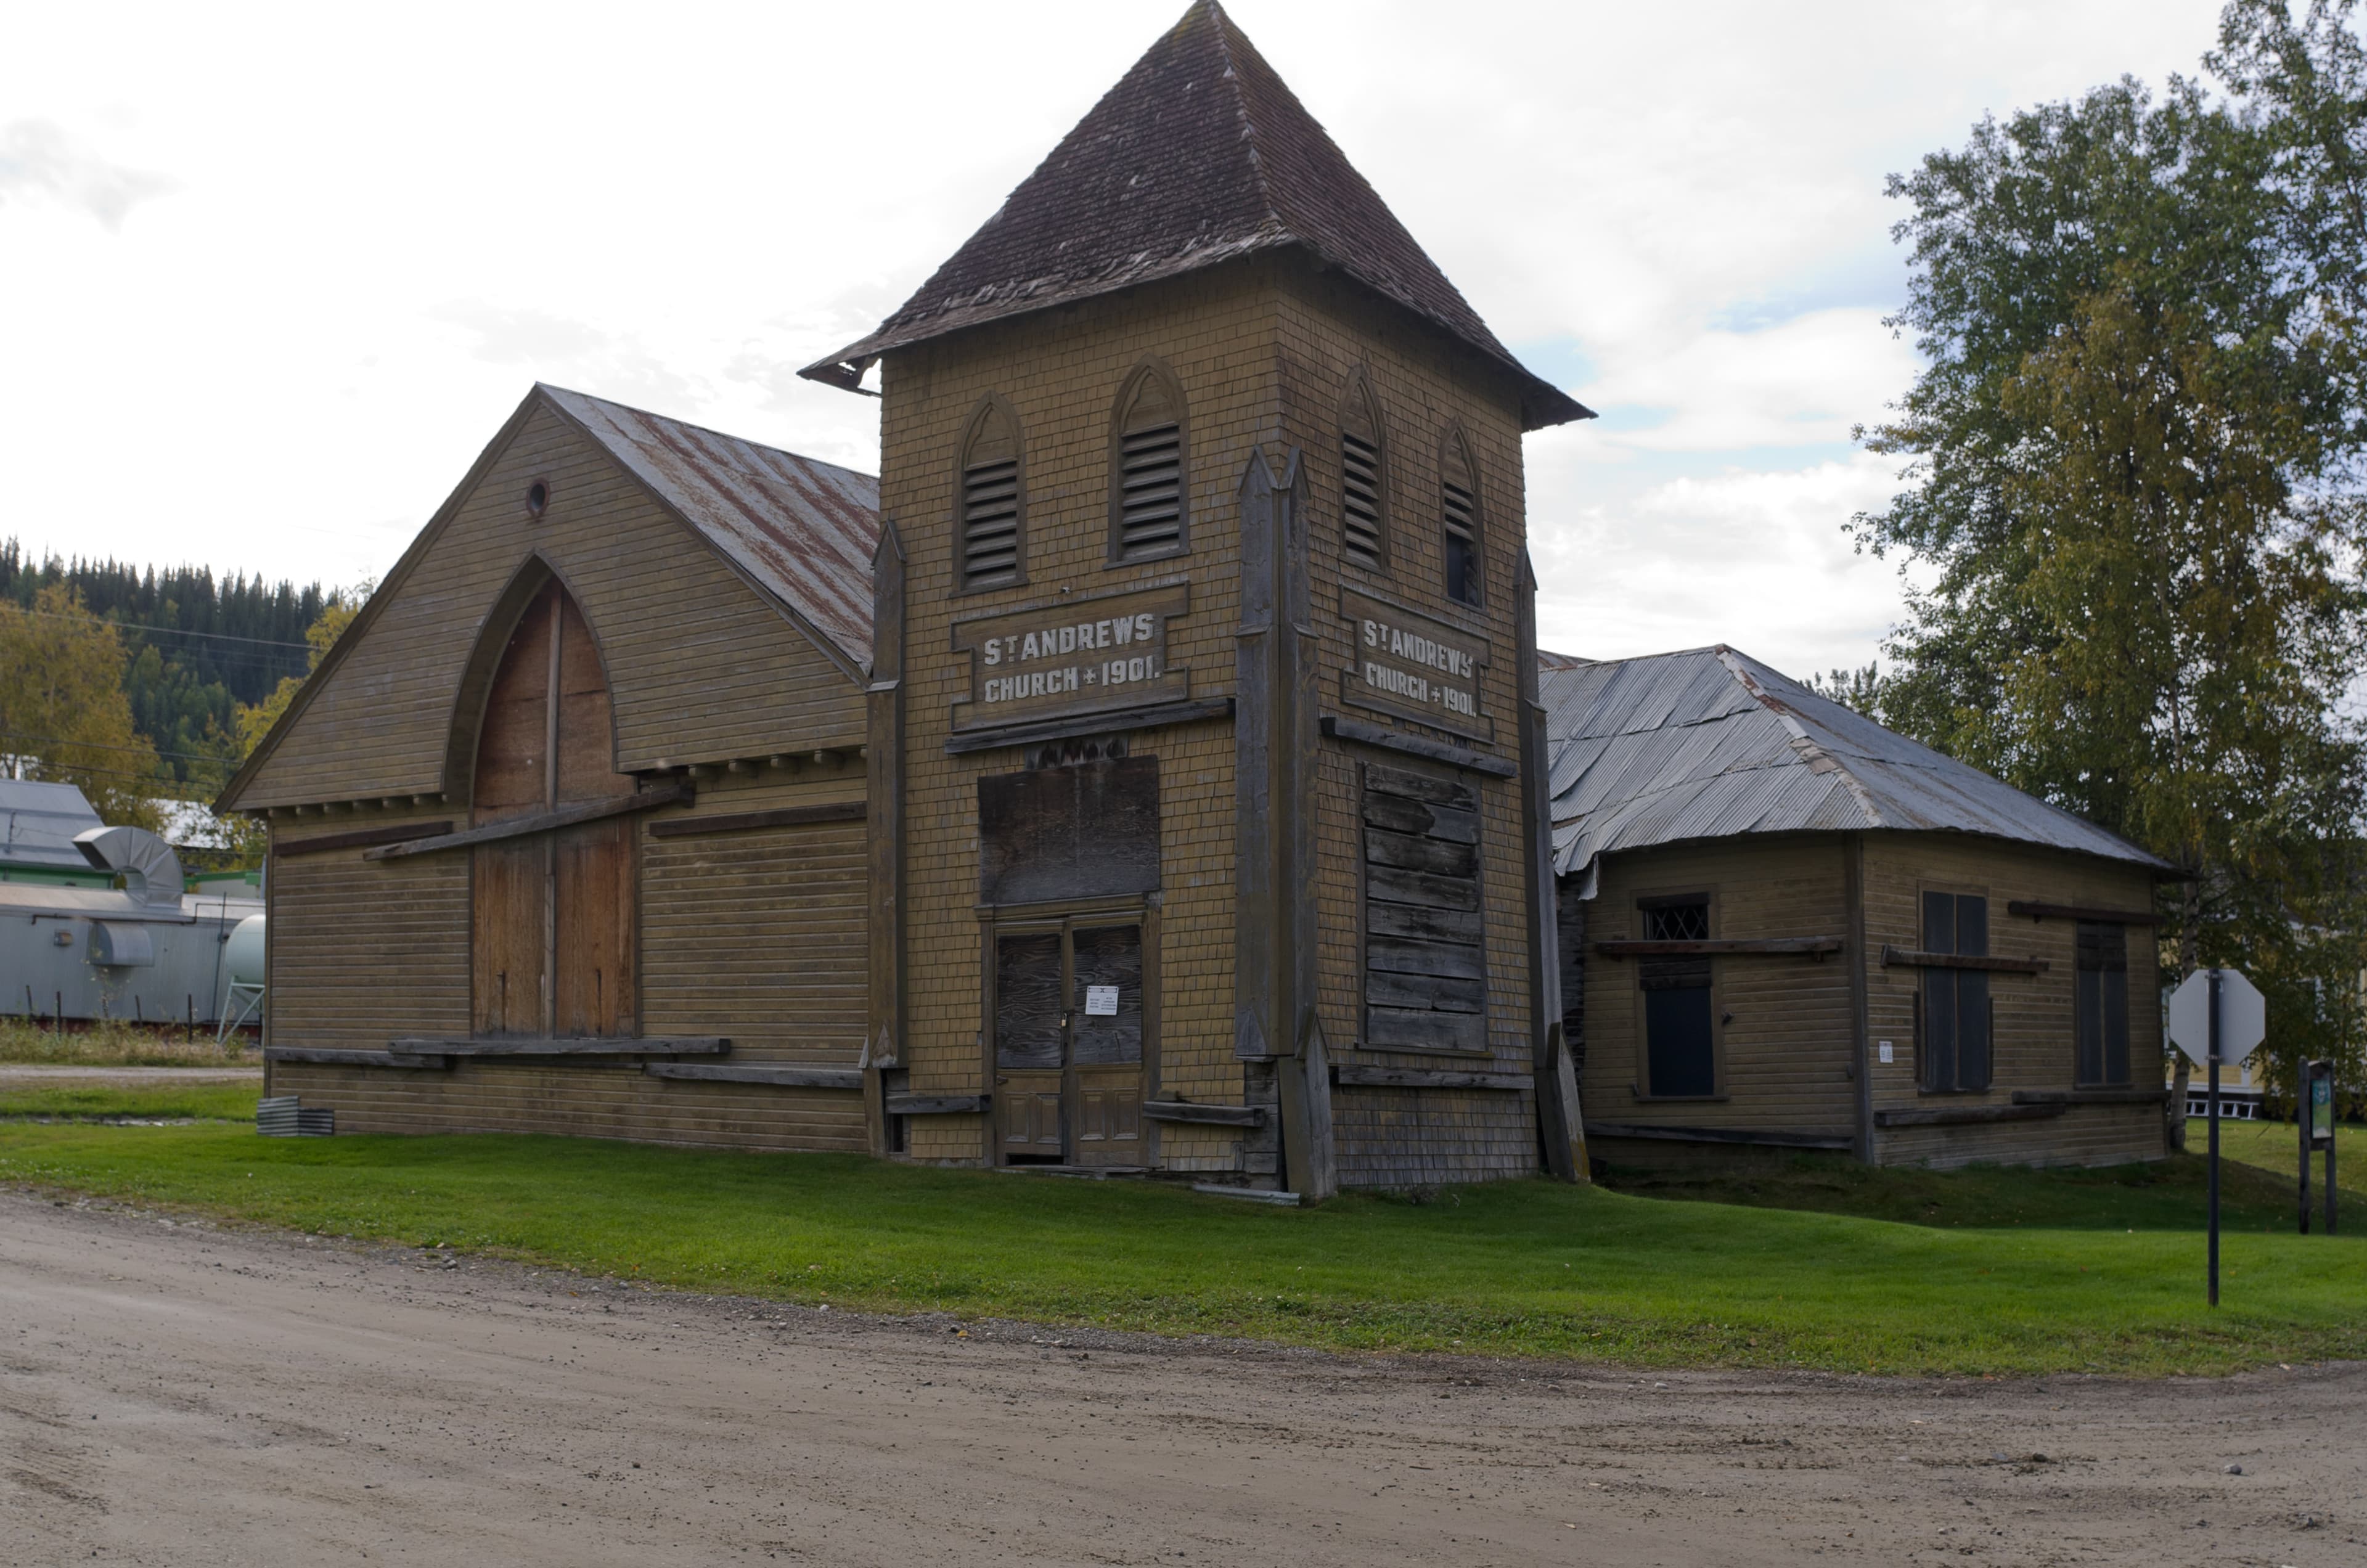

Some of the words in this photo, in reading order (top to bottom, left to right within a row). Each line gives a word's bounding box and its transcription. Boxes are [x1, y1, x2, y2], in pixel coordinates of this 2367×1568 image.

[1021, 613, 1155, 661] ANDREWS
[985, 667, 1079, 703] CHURCH
[1365, 662, 1428, 702] CHURCH
